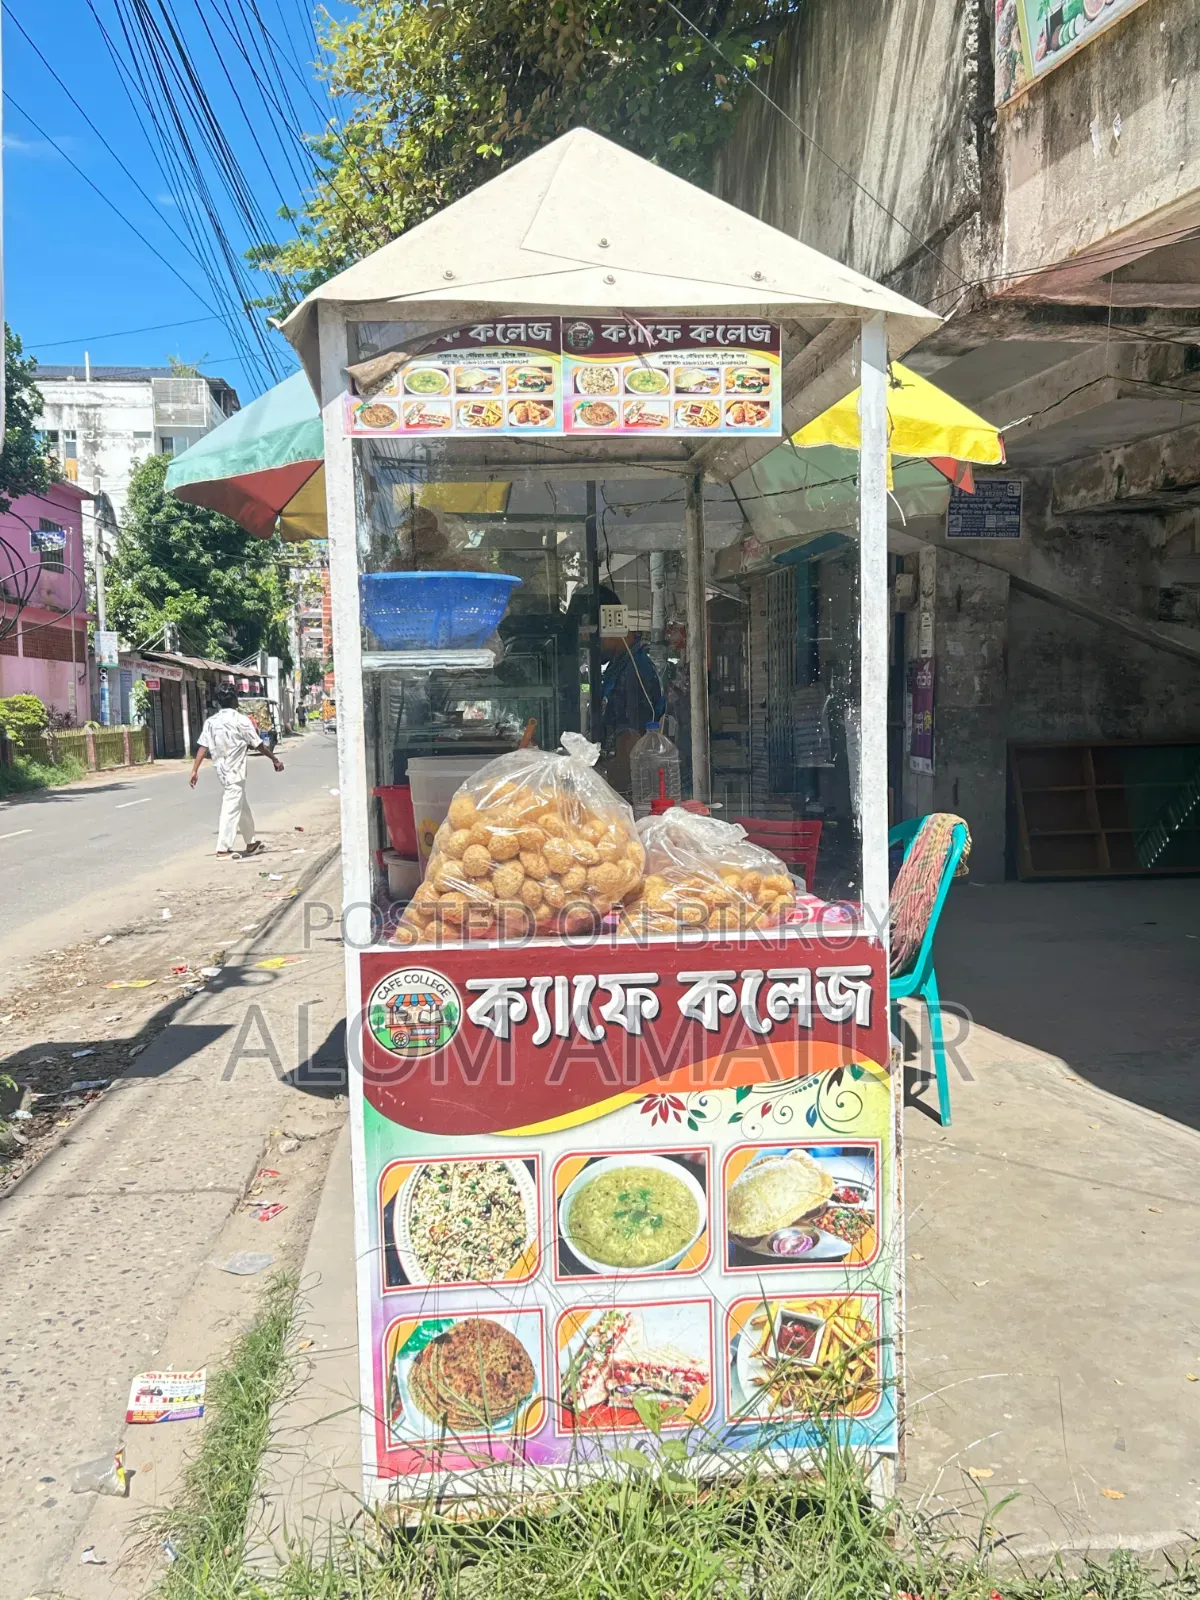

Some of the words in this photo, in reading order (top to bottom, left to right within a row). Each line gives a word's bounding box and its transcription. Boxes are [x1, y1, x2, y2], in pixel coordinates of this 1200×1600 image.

[469, 323, 552, 344] কলেজ
[601, 324, 682, 346] ক্যাফে
[689, 324, 771, 345] কলেজ
[377, 977, 403, 1000] CAFE
[404, 974, 451, 998] COLLEGE
[466, 973, 661, 1046] ক্যাফে
[677, 965, 873, 1034] কলেজ
